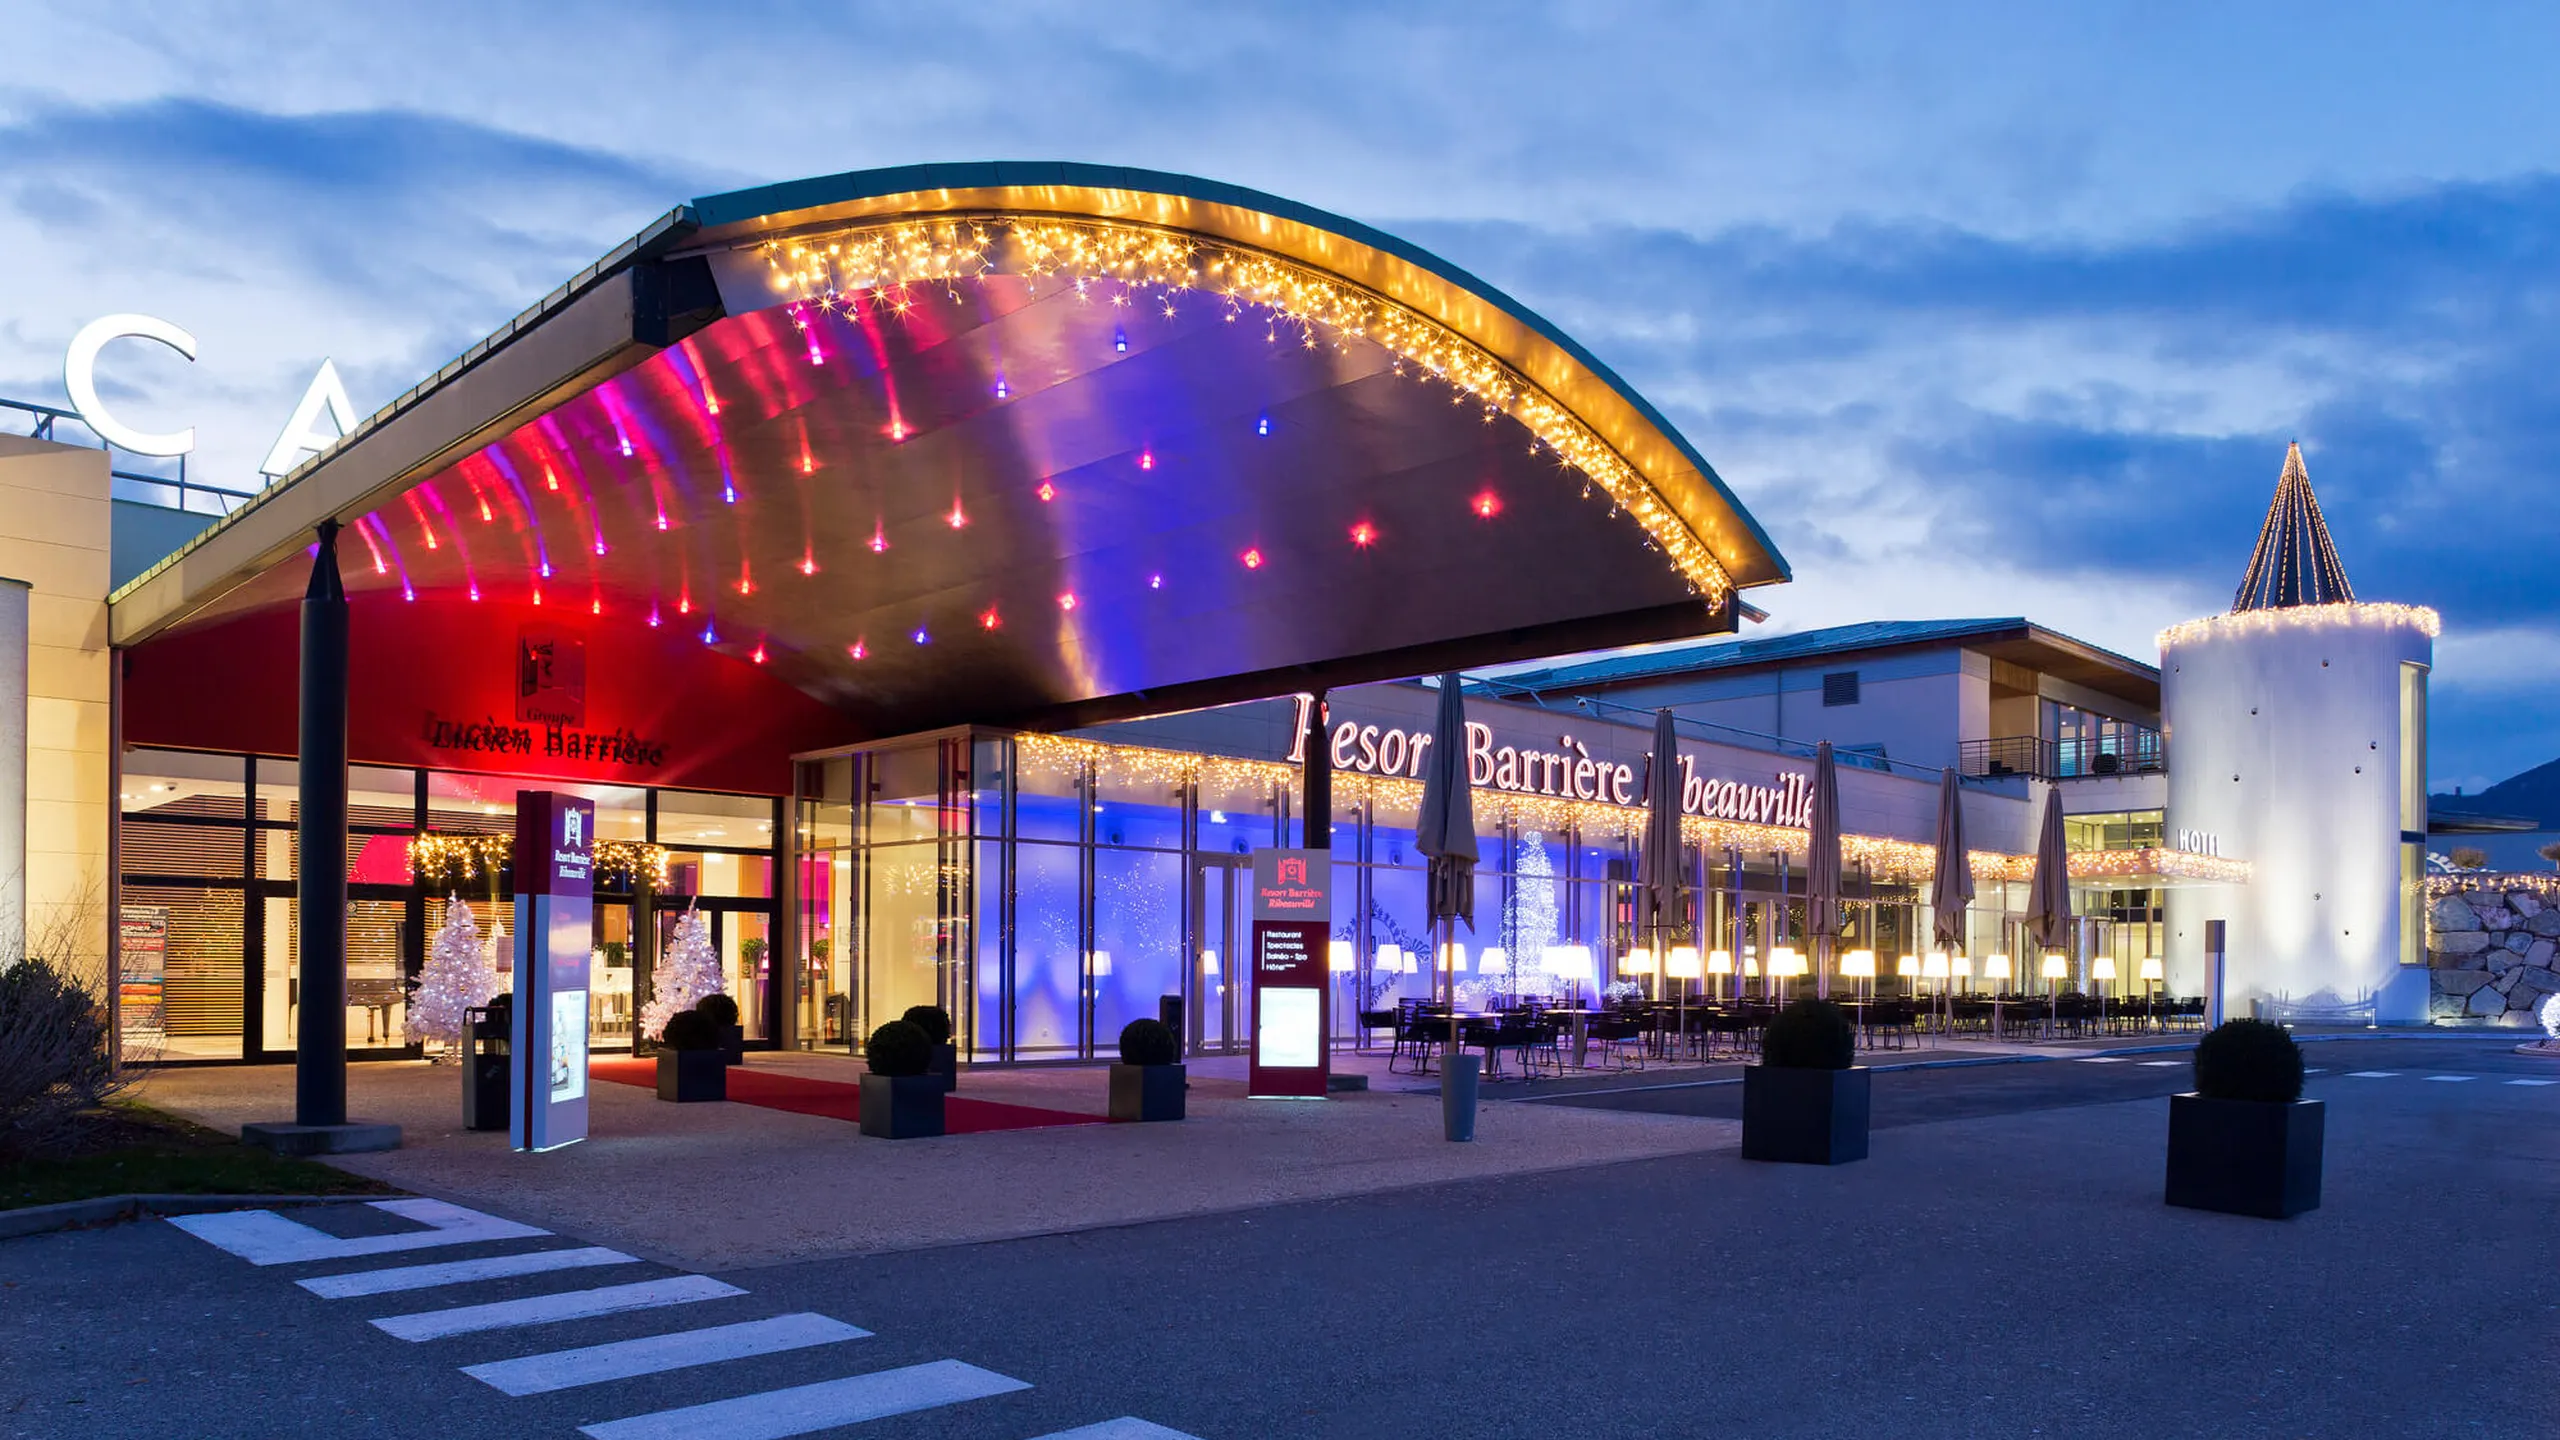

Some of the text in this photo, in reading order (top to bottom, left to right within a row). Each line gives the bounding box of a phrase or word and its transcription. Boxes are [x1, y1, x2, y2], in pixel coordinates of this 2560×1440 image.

[526, 708, 576, 729] Groupe
[1287, 692, 1431, 777] esor
[1464, 721, 1633, 805] Barrière
[1261, 888, 1287, 897] Resort
[1267, 942, 1304, 950] Spectacles
